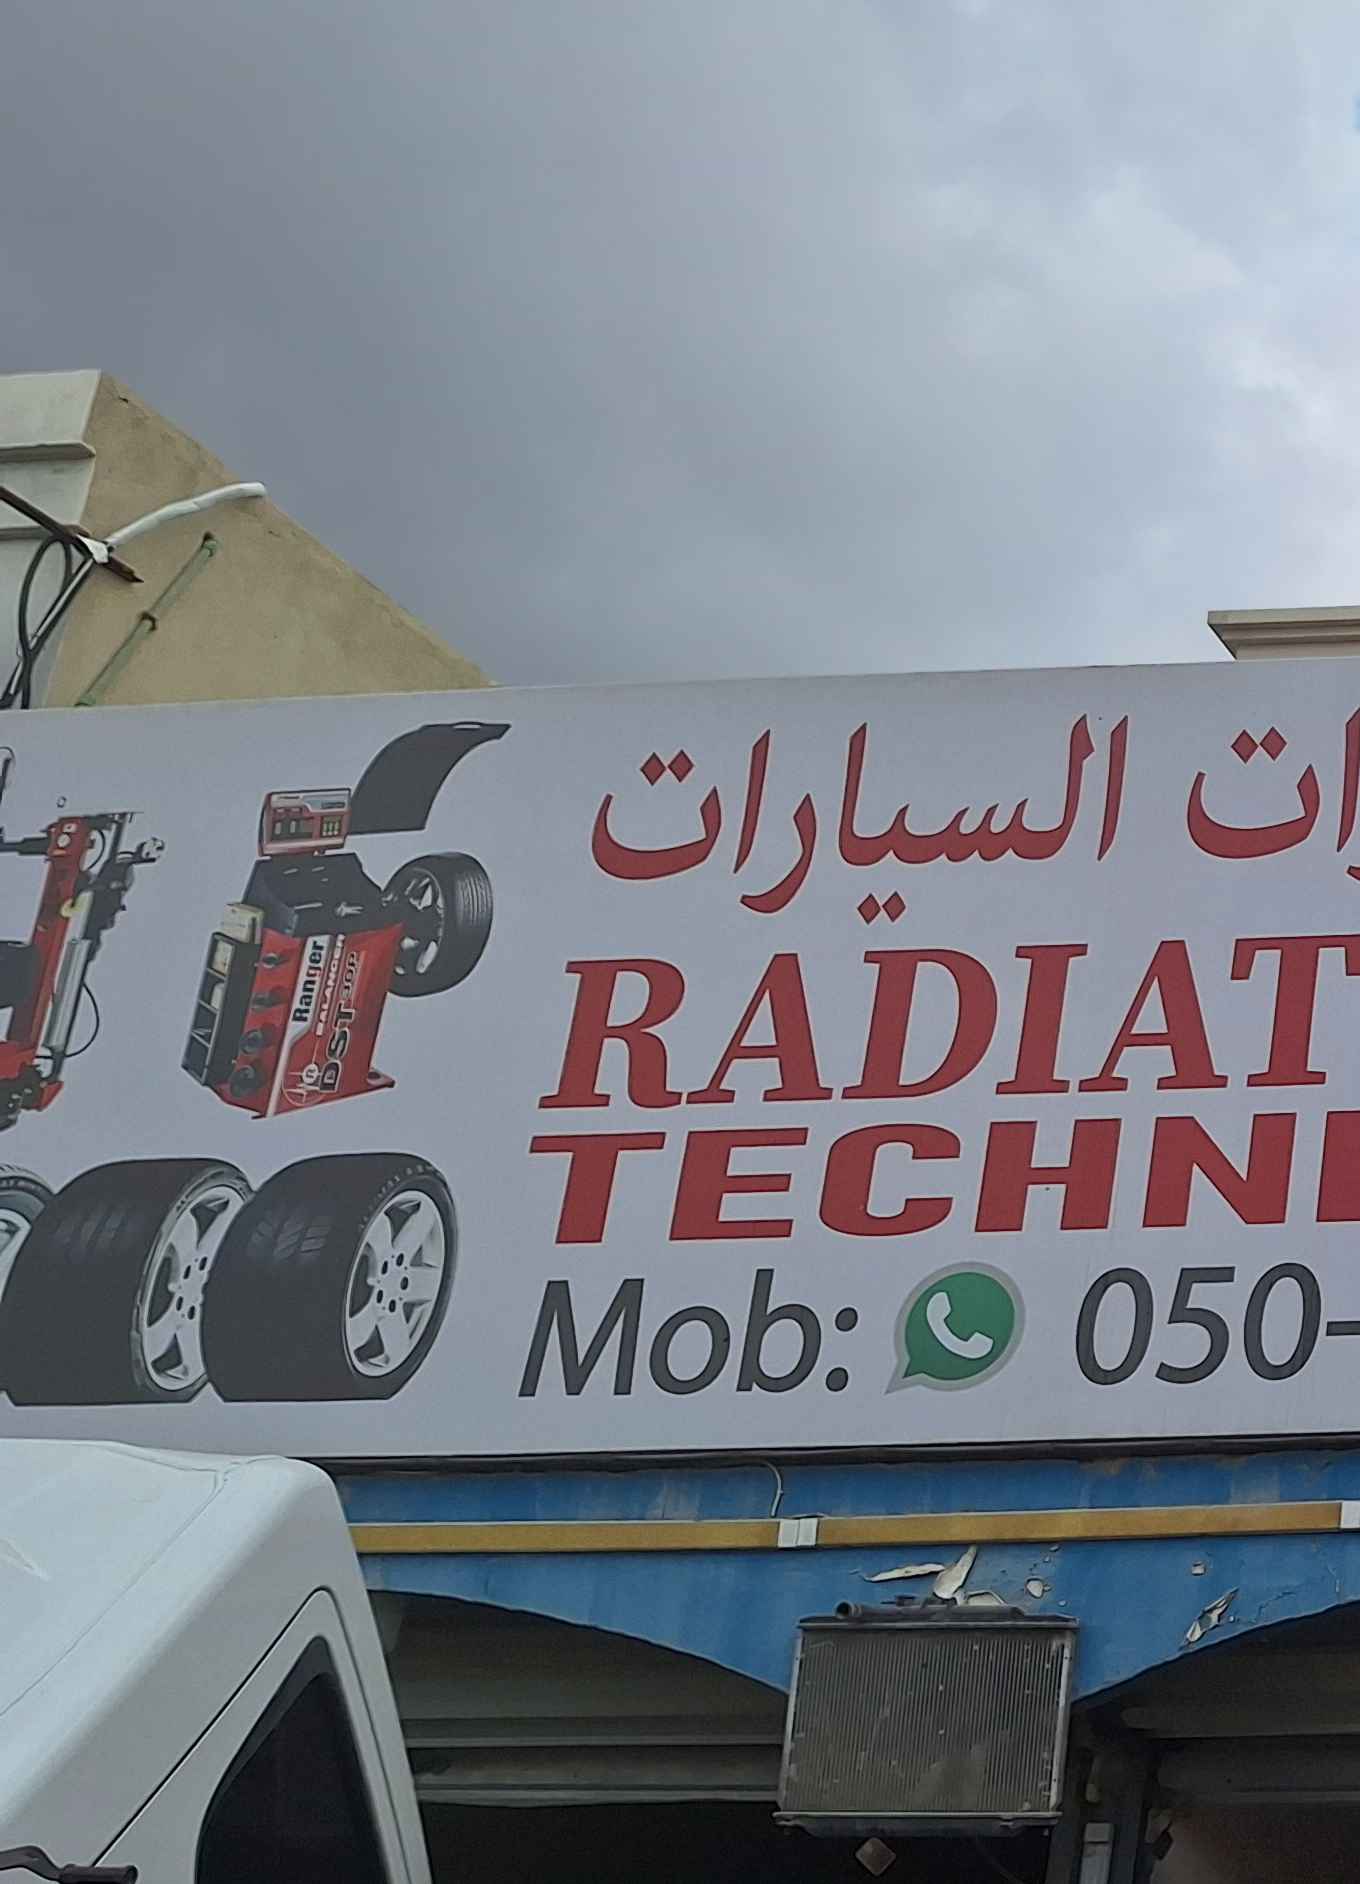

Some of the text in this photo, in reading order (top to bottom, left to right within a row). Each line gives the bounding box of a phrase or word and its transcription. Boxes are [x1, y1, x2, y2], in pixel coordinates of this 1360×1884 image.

[591, 713, 1129, 925] السيارات
[291, 939, 325, 1023] Ranger
[517, 1267, 860, 1398] Mob:
